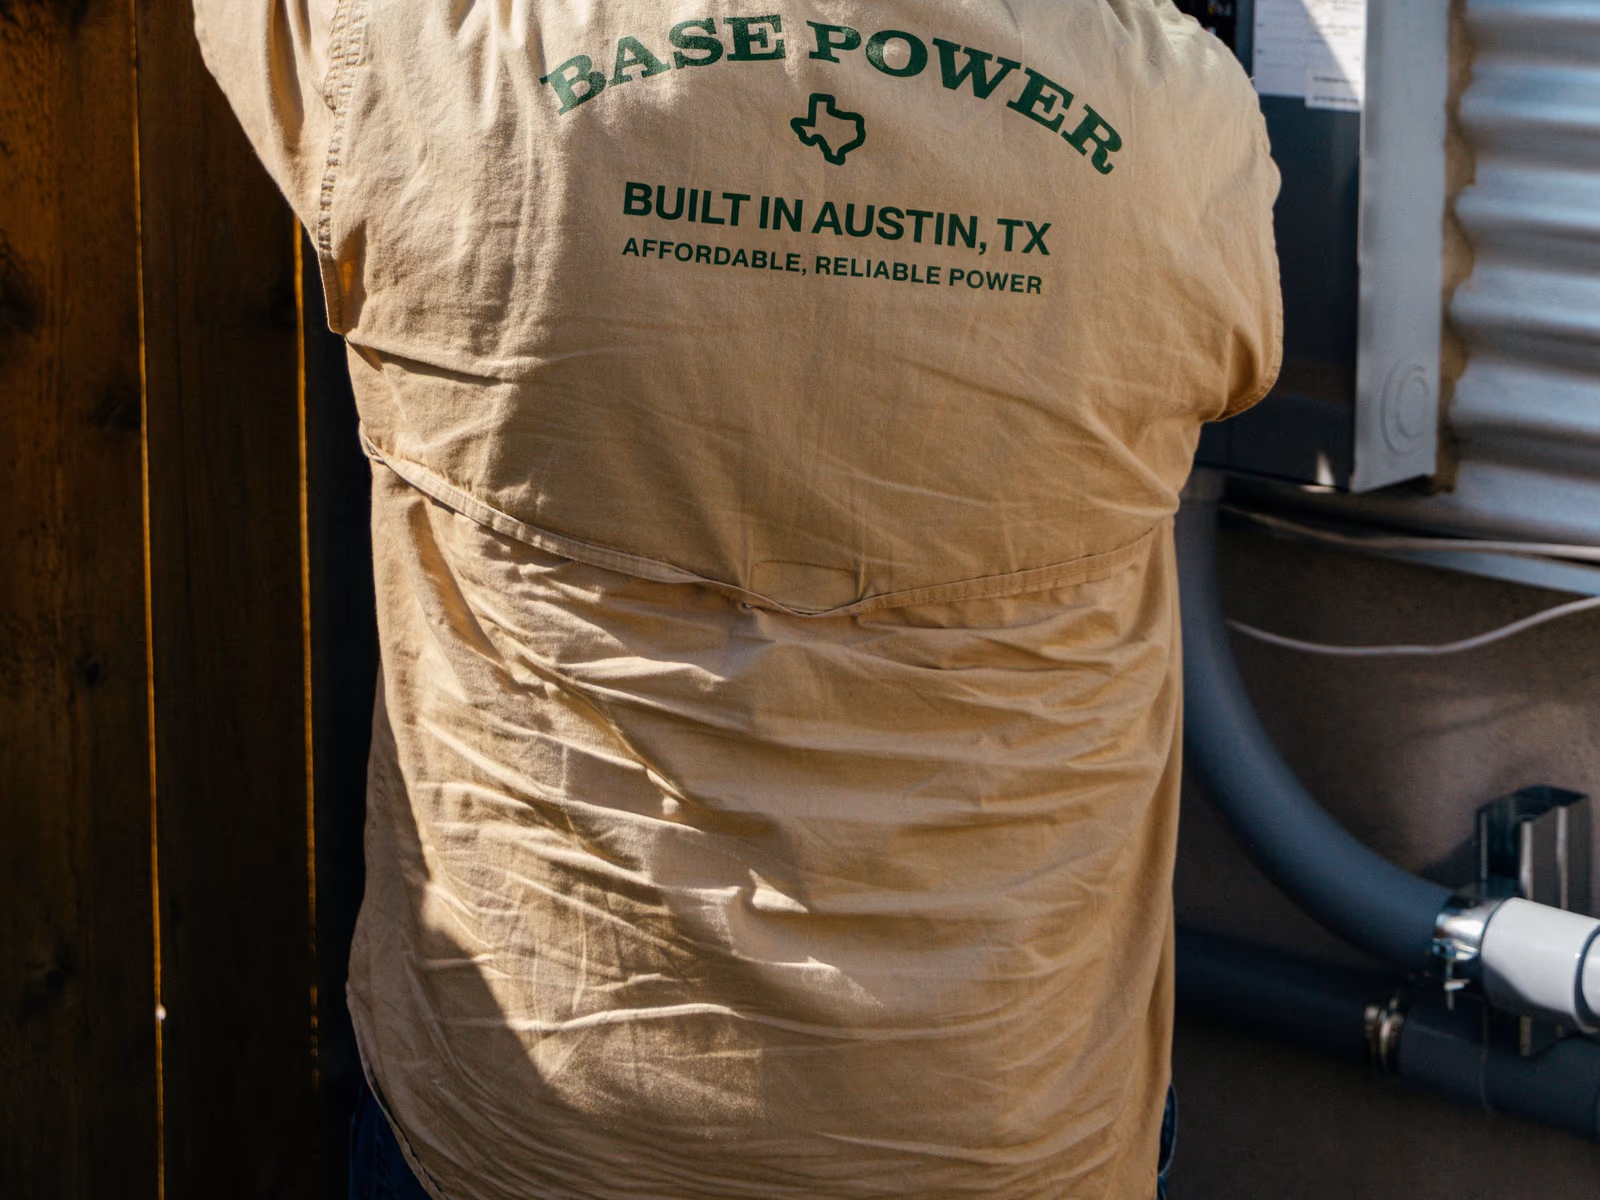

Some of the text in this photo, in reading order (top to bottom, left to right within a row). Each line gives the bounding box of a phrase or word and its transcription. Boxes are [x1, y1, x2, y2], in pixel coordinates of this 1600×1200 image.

[539, 14, 1123, 175] BASE POWER
[622, 181, 1052, 256] BUILT IN AUSTIN, TX
[621, 237, 1042, 295] AFFORDABLE, RELIABLE POWER
